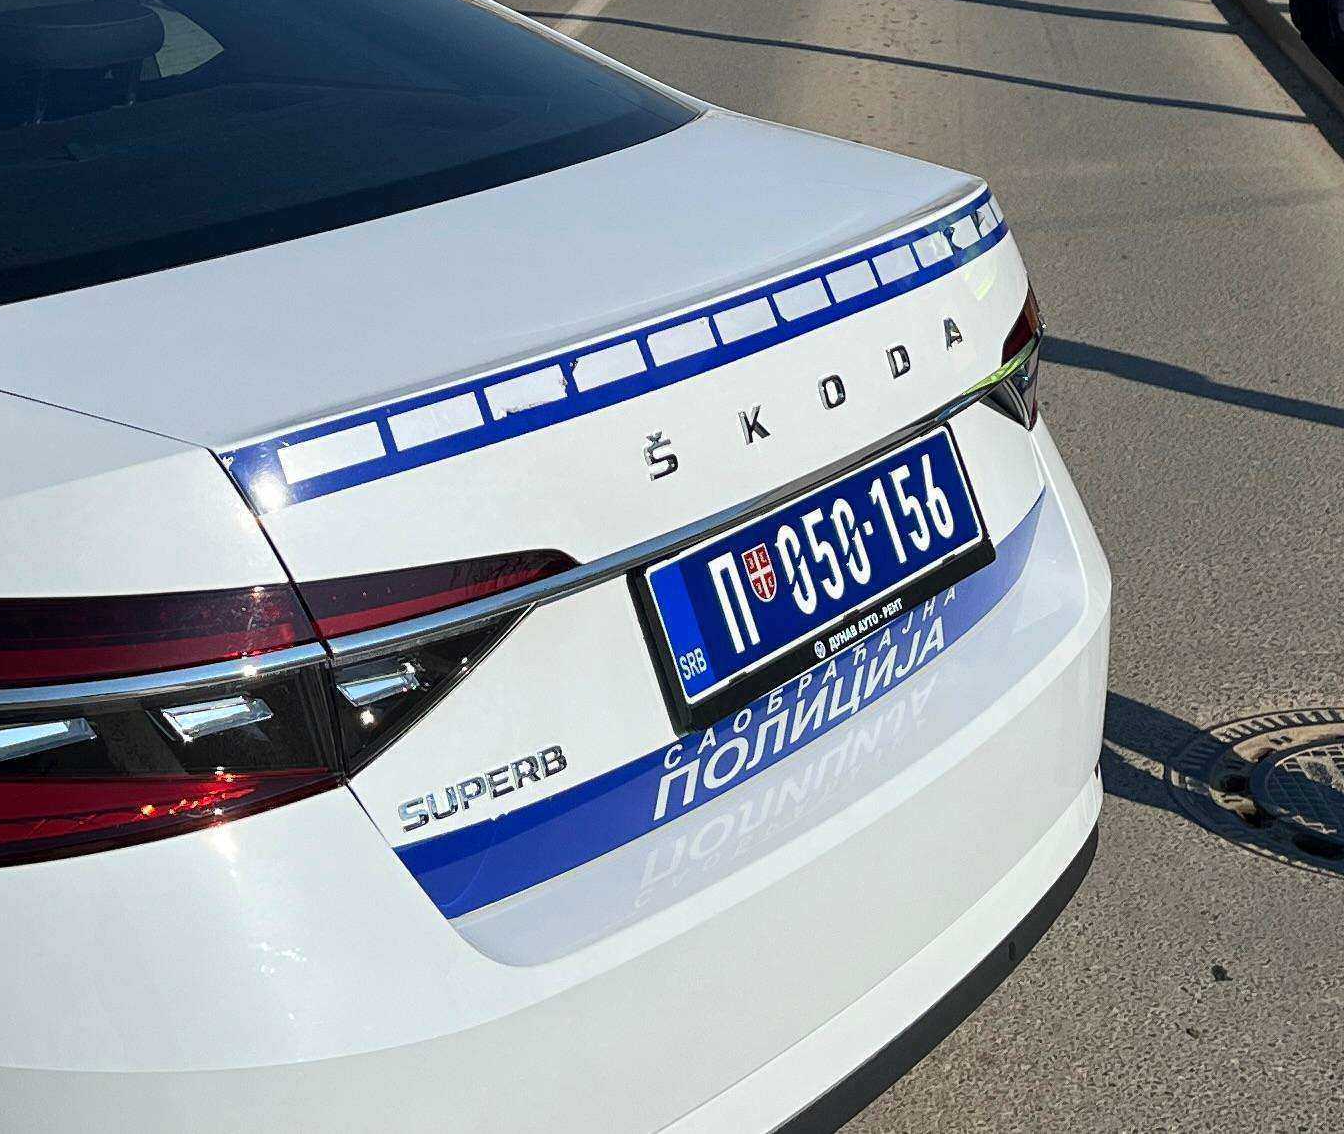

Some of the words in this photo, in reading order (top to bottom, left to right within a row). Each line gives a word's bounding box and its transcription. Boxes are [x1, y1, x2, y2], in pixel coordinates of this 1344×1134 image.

[642, 316, 964, 482] ŠKODA
[708, 551, 761, 654] П
[828, 624, 859, 653] ДУНАВ
[857, 612, 880, 634] АУТО
[882, 597, 903, 619] РЕНТ
[664, 584, 957, 769] САОБРАЋАЈНА
[678, 646, 708, 681] SRB
[652, 616, 945, 822] ПОЛИЦИЈА
[398, 744, 568, 833] SUPERB
